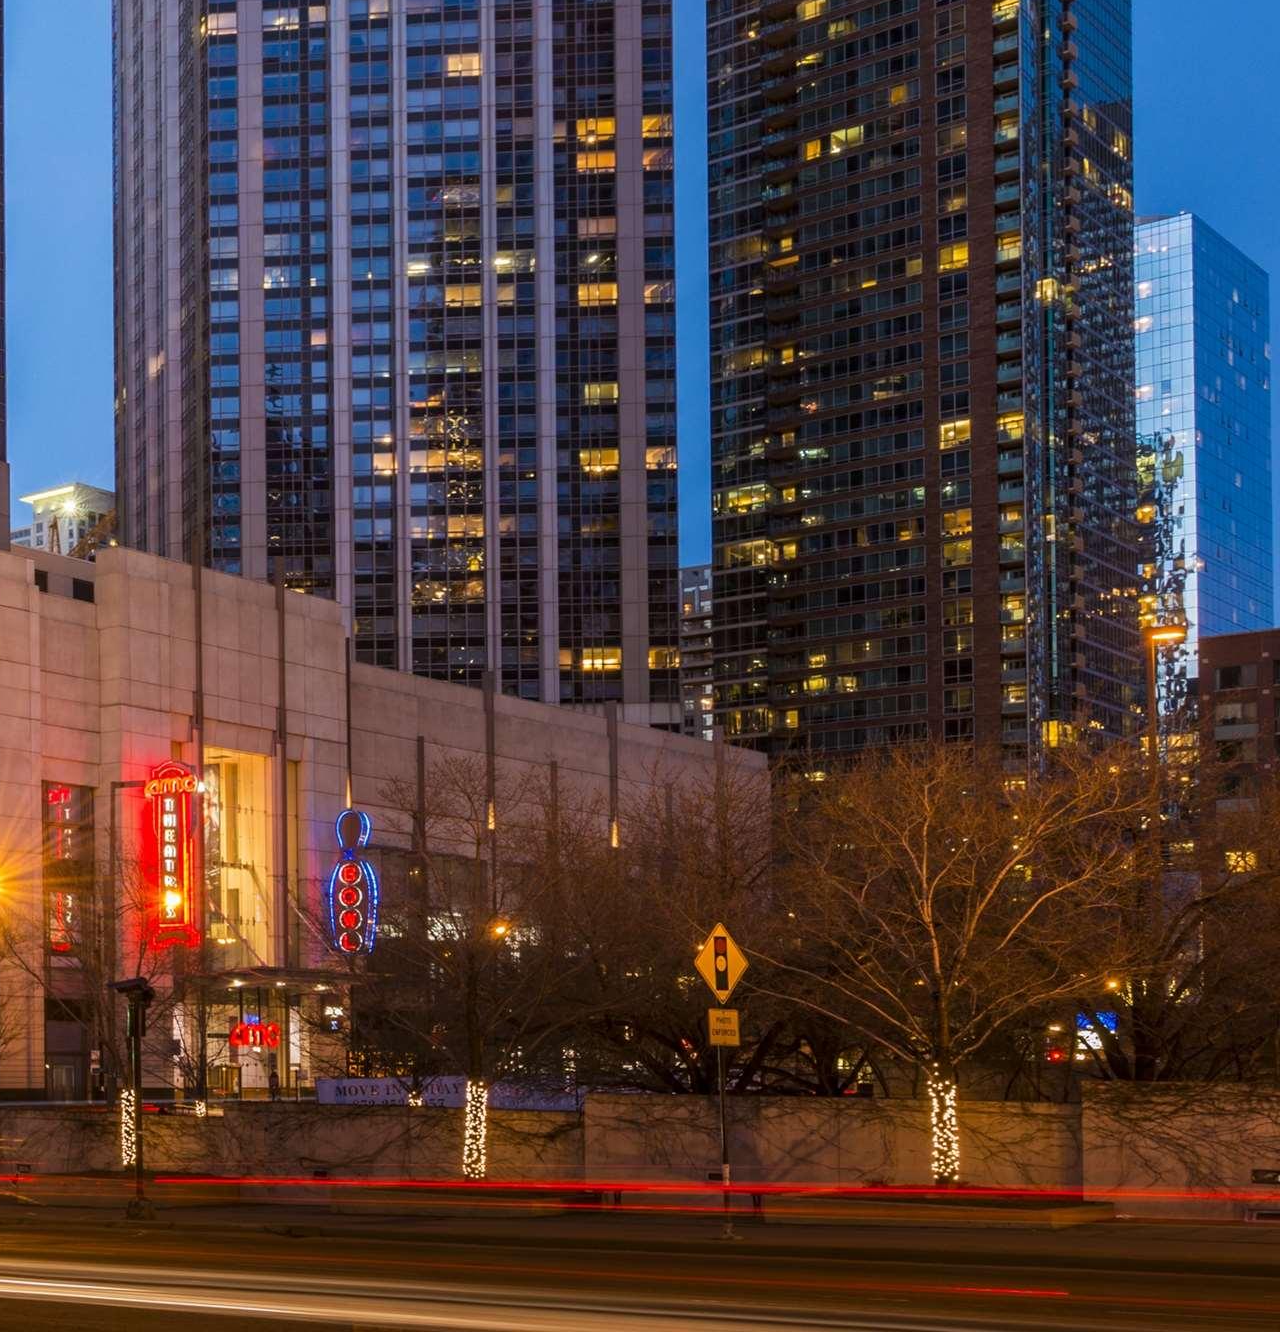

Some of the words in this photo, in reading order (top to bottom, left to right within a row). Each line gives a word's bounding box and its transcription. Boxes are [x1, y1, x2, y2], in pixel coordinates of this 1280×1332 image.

[145, 775, 198, 797] amc
[163, 798, 177, 918] THEATRS
[335, 1085, 380, 1097] MOVE
[384, 1084, 401, 1096] IN
